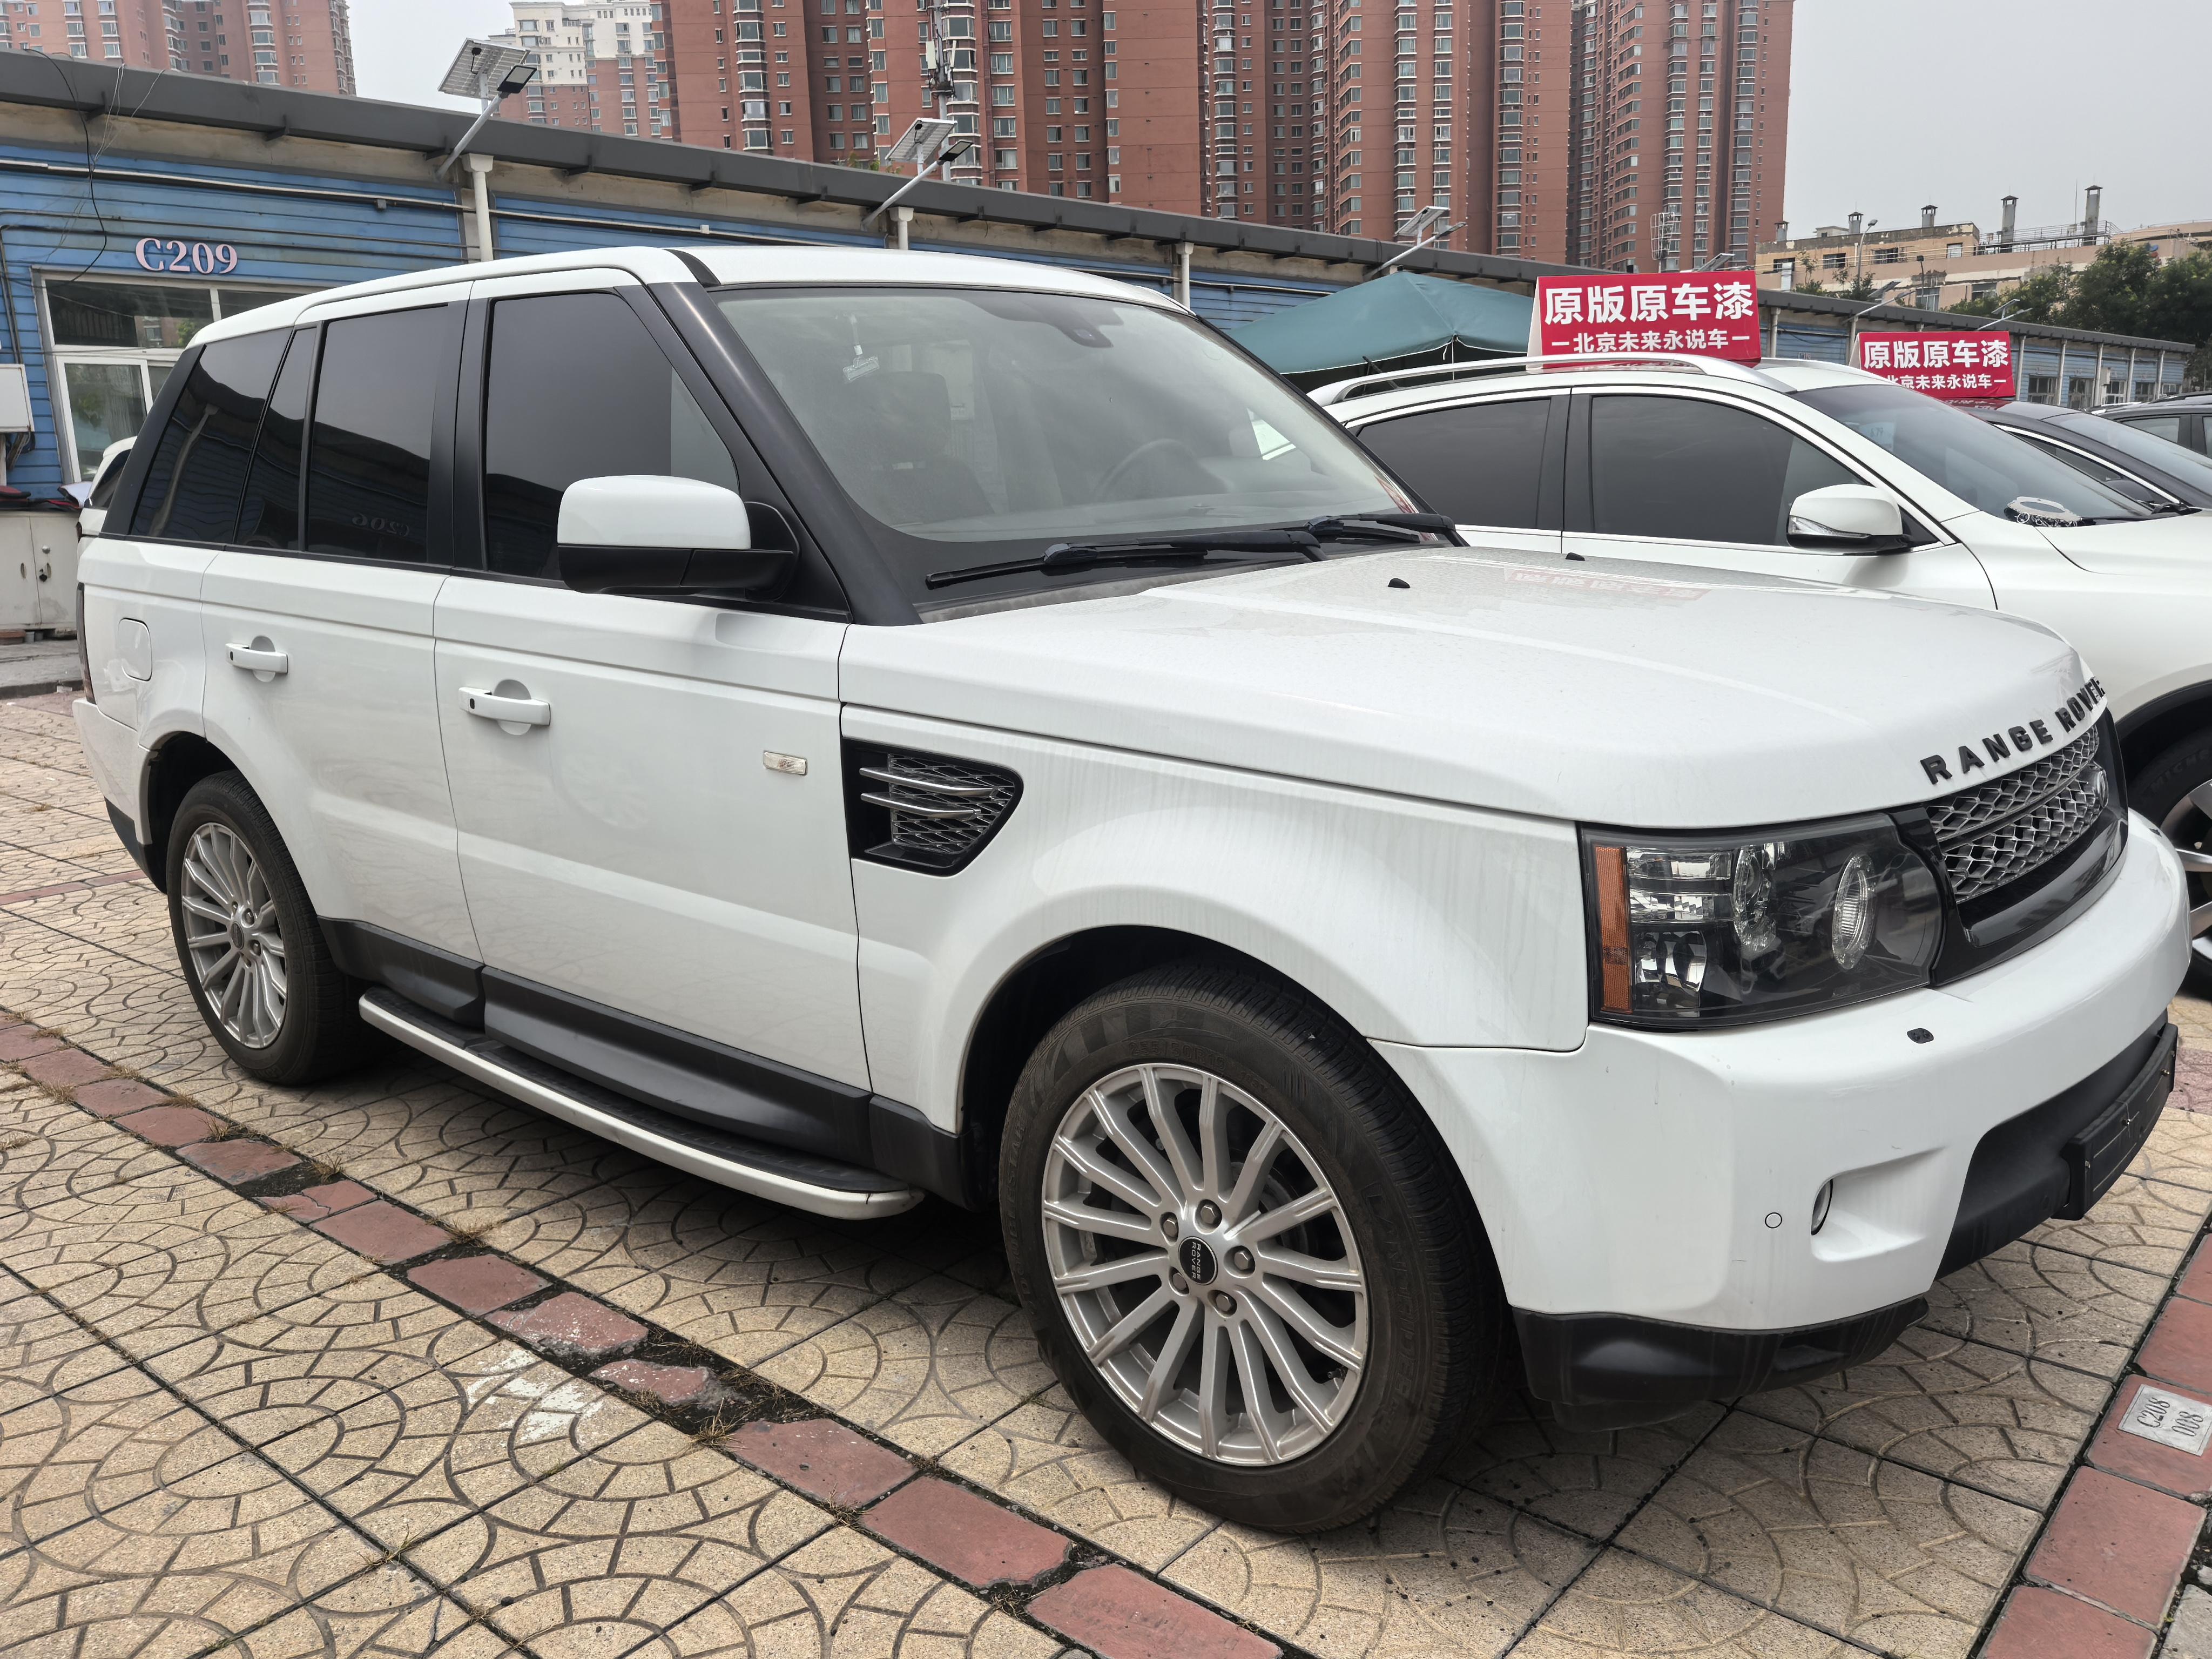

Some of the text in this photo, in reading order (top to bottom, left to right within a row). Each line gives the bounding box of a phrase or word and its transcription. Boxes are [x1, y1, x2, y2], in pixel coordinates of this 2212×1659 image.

[135, 238, 238, 275] C209
[1545, 281, 1754, 325] 原版原车漆
[1864, 340, 2009, 369] 原版原车漆
[1919, 719, 2053, 785] RANGE
[2137, 1397, 2170, 1428] C208
